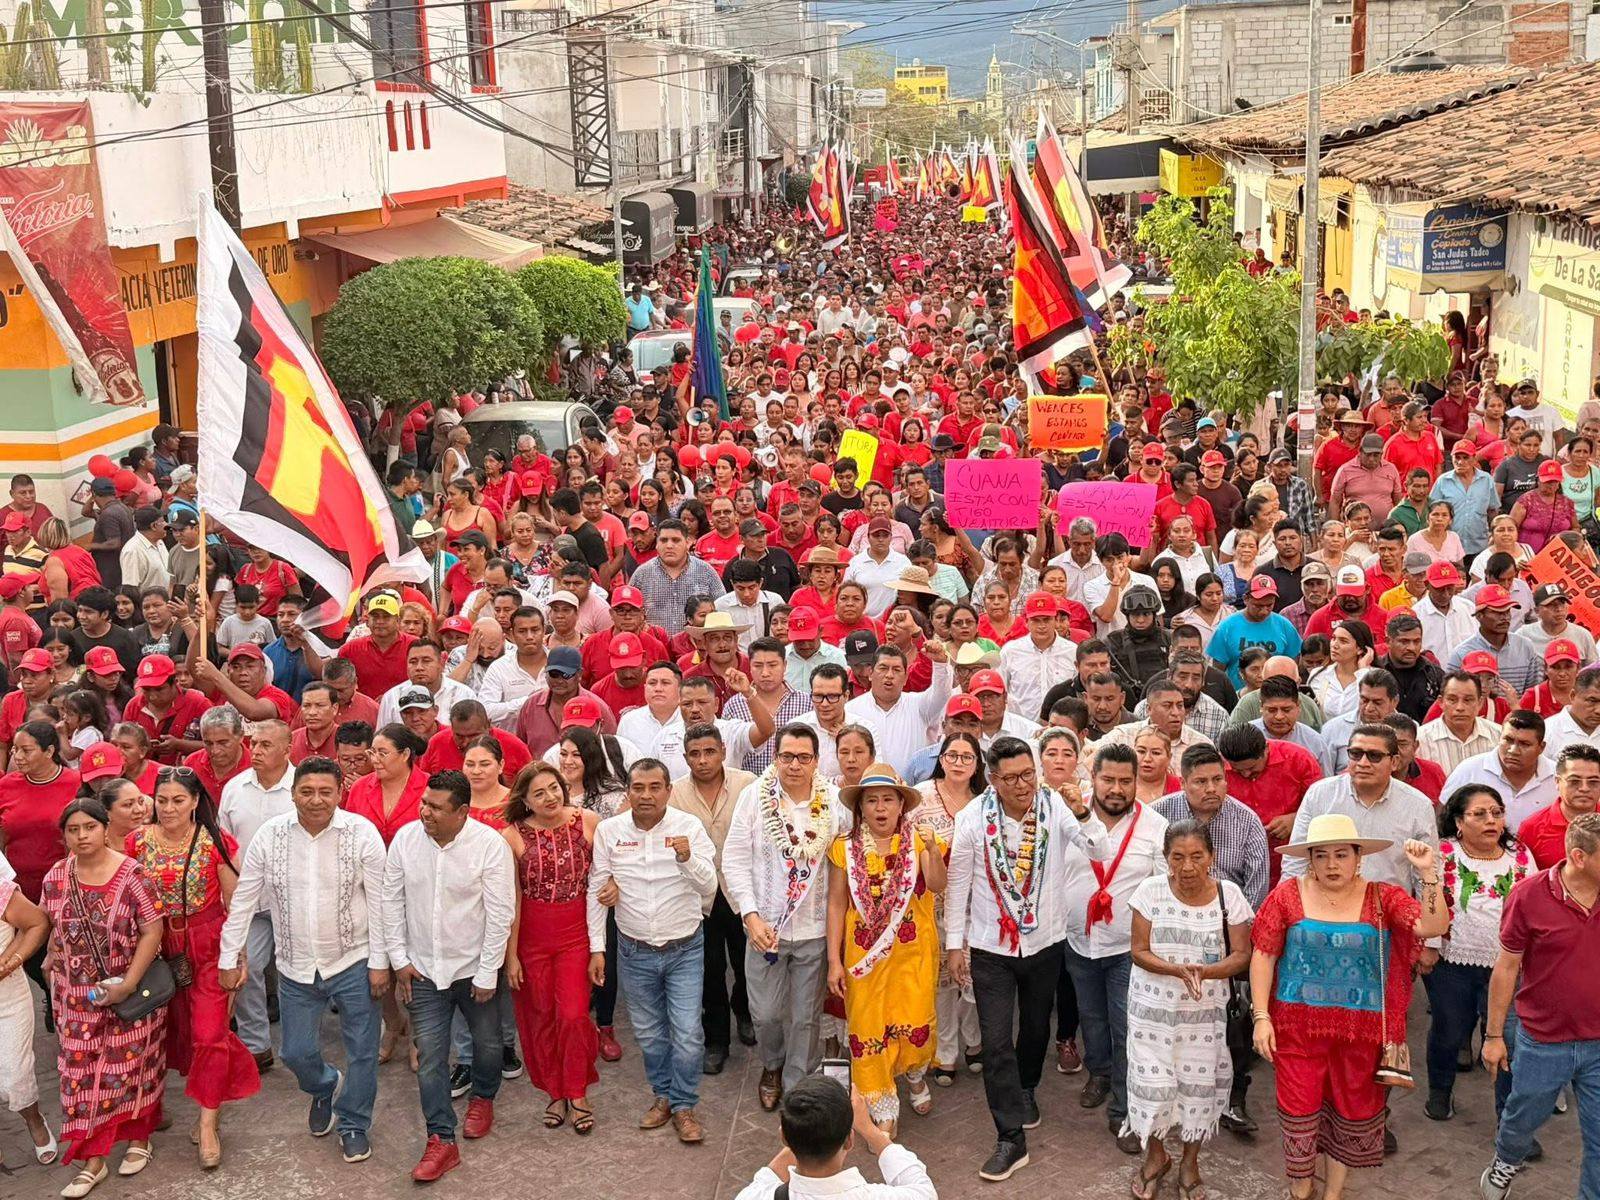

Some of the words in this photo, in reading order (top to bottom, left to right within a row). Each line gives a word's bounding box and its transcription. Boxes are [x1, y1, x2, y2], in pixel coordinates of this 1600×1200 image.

[271, 243, 288, 275] ORO
[1432, 250, 1445, 260] San
[1447, 249, 1468, 259] Judas
[1470, 247, 1490, 257] Tadeo
[1554, 255, 1568, 280] De
[1571, 259, 1585, 287] La
